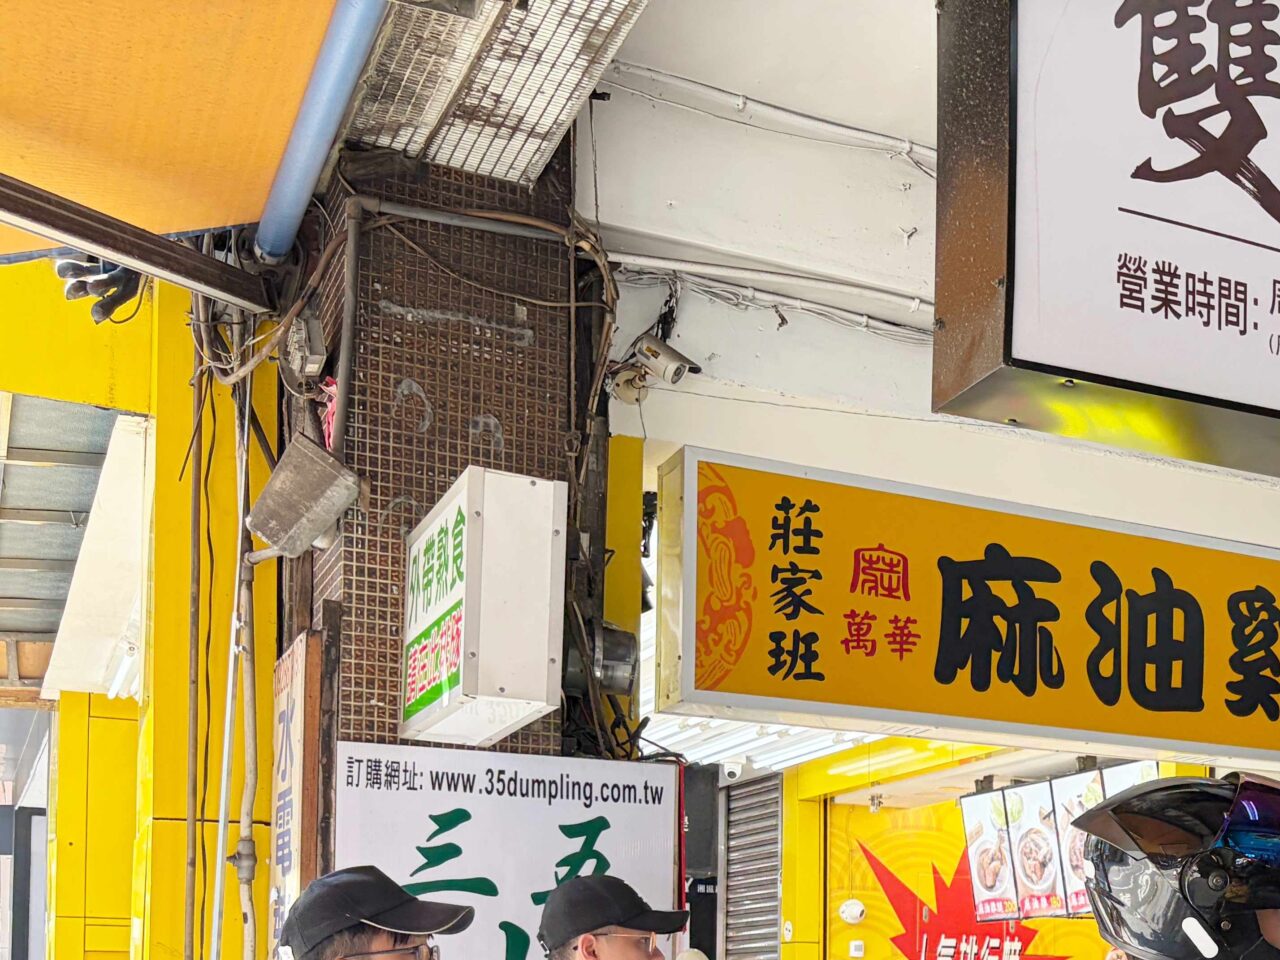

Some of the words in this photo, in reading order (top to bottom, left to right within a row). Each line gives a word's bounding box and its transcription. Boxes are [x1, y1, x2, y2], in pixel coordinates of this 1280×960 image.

[1116, 252, 1259, 336] 營業時間:
[408, 504, 466, 629] 外帶熟食
[767, 495, 825, 682] 莊家班
[840, 608, 922, 662] 萬華
[345, 756, 424, 792] 訂購網址:
[429, 769, 665, 807] www.35dumpling.com.tw
